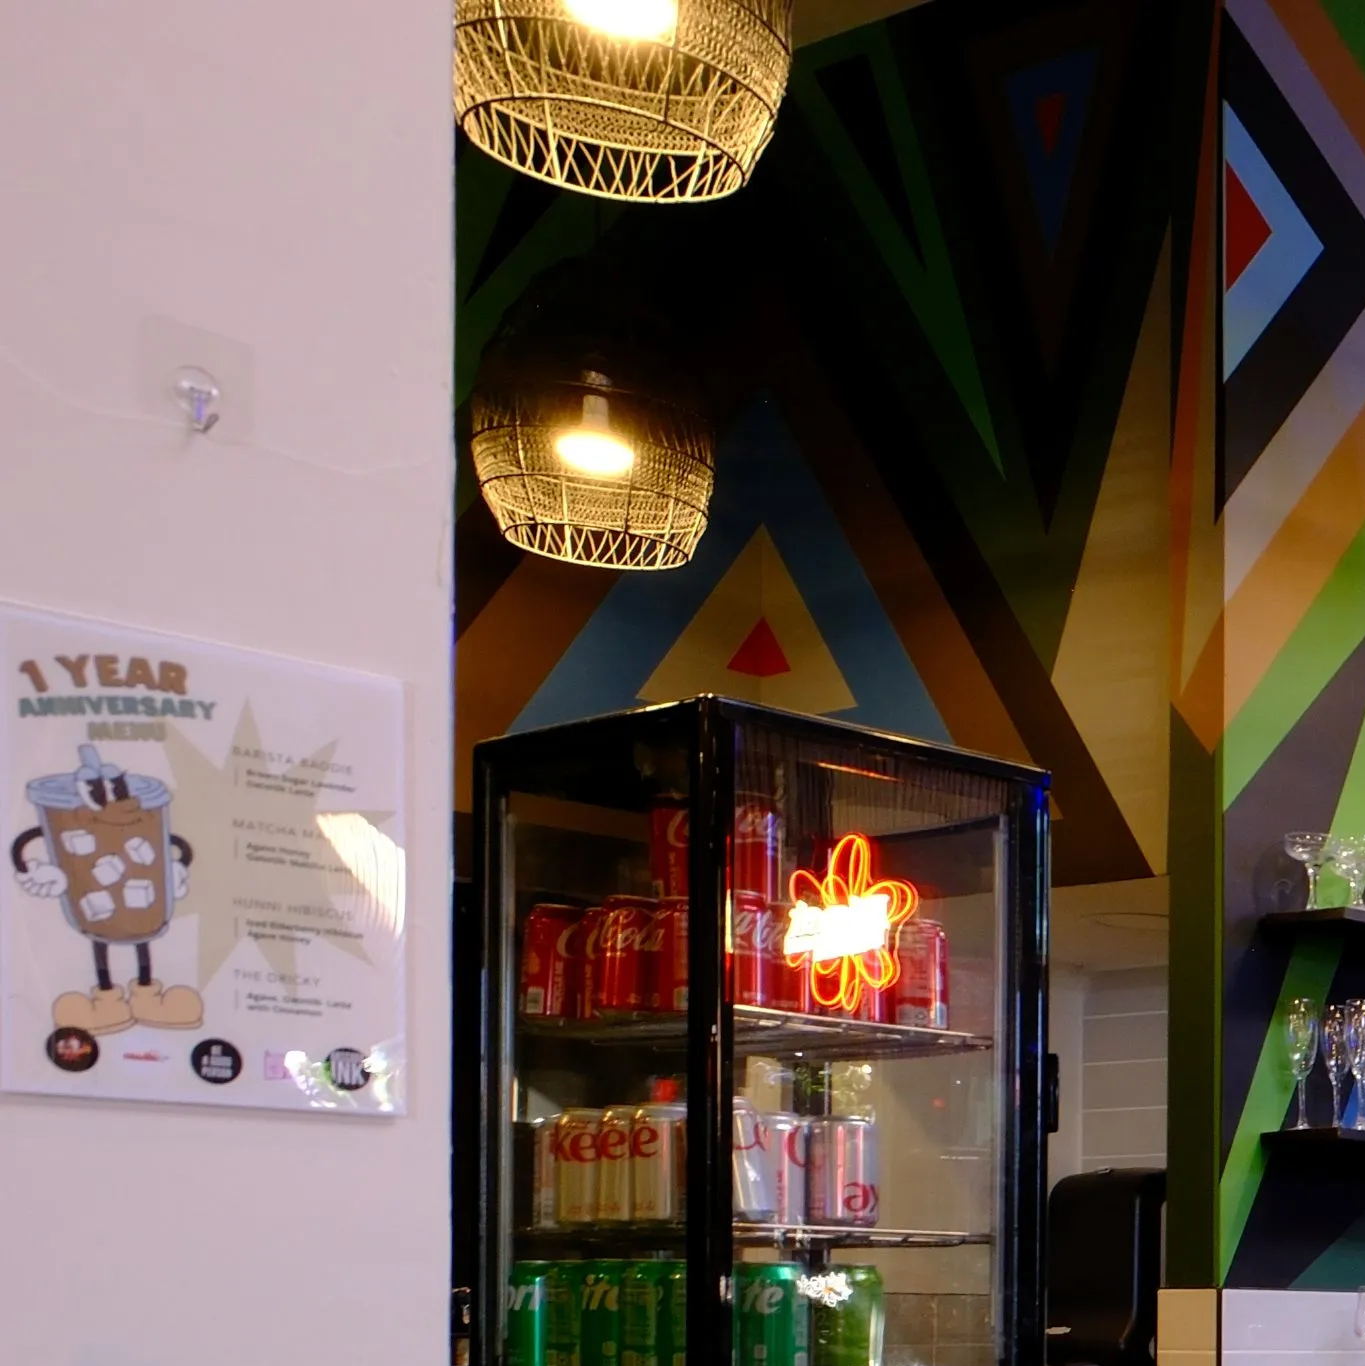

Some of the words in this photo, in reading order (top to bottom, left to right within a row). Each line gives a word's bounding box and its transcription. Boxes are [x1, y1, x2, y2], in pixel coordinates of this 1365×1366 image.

[18, 659, 49, 693] 1
[54, 653, 188, 696] YEAR
[18, 695, 217, 721] ANNIVERSARY
[86, 721, 168, 742] MENU
[232, 745, 295, 765] BARISTA
[232, 818, 297, 837] MATCHA
[287, 903, 356, 922] HIBISCUS
[233, 968, 263, 983] THE
